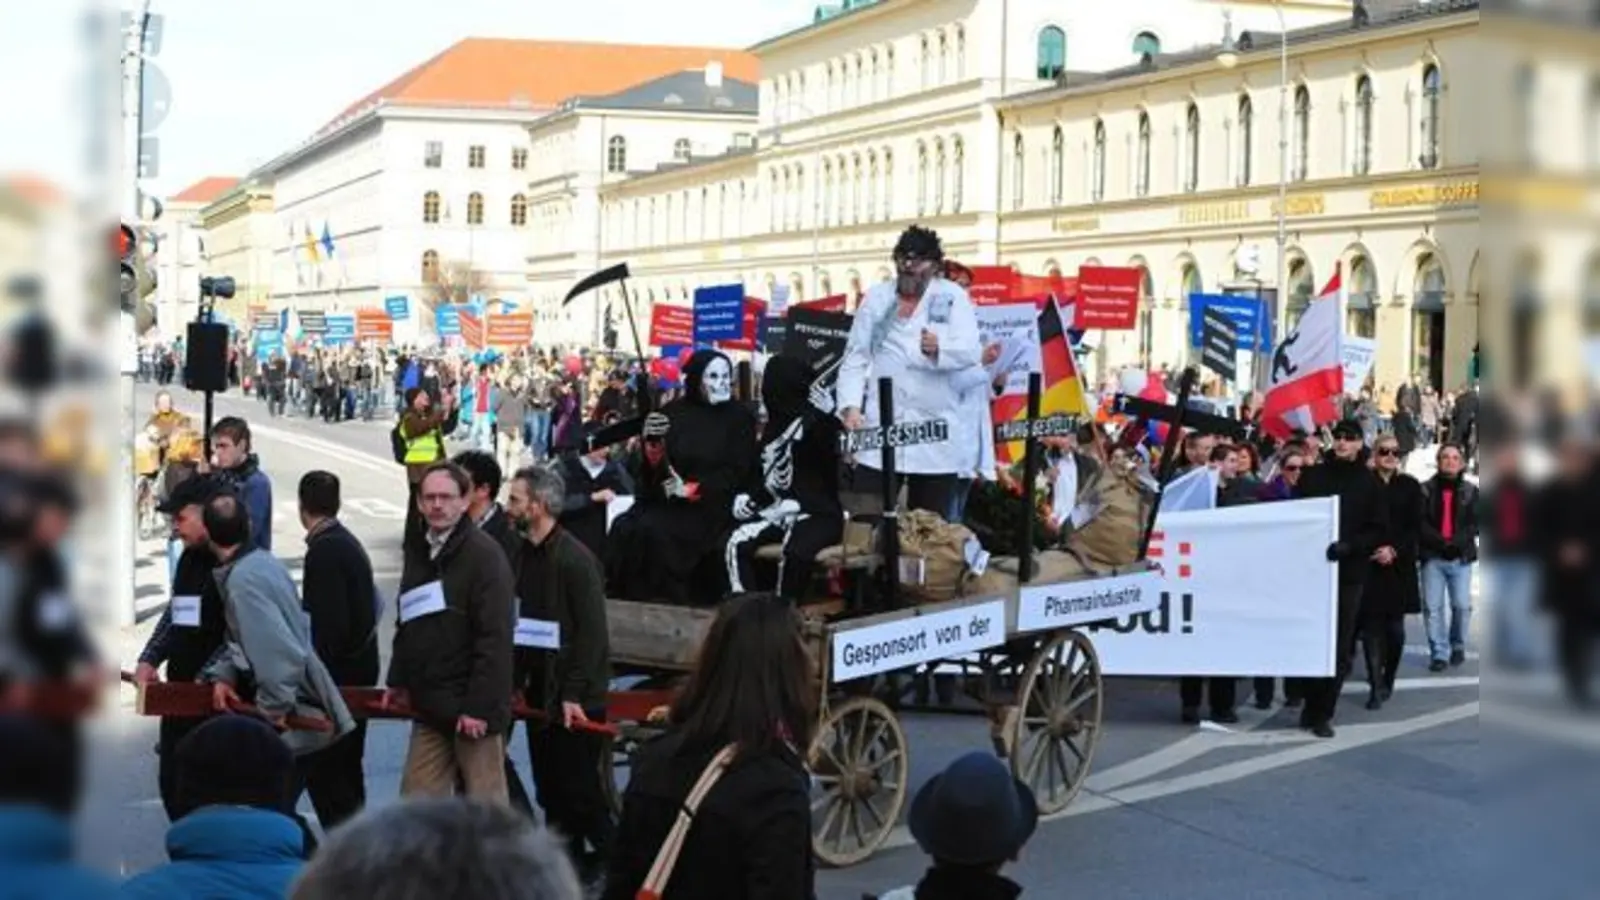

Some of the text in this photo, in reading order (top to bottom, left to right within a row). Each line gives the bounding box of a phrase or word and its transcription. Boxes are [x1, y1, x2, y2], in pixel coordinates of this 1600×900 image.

[1044, 585, 1142, 617] Pharmaindustrie
[842, 616, 990, 667] Gesponsort von der
